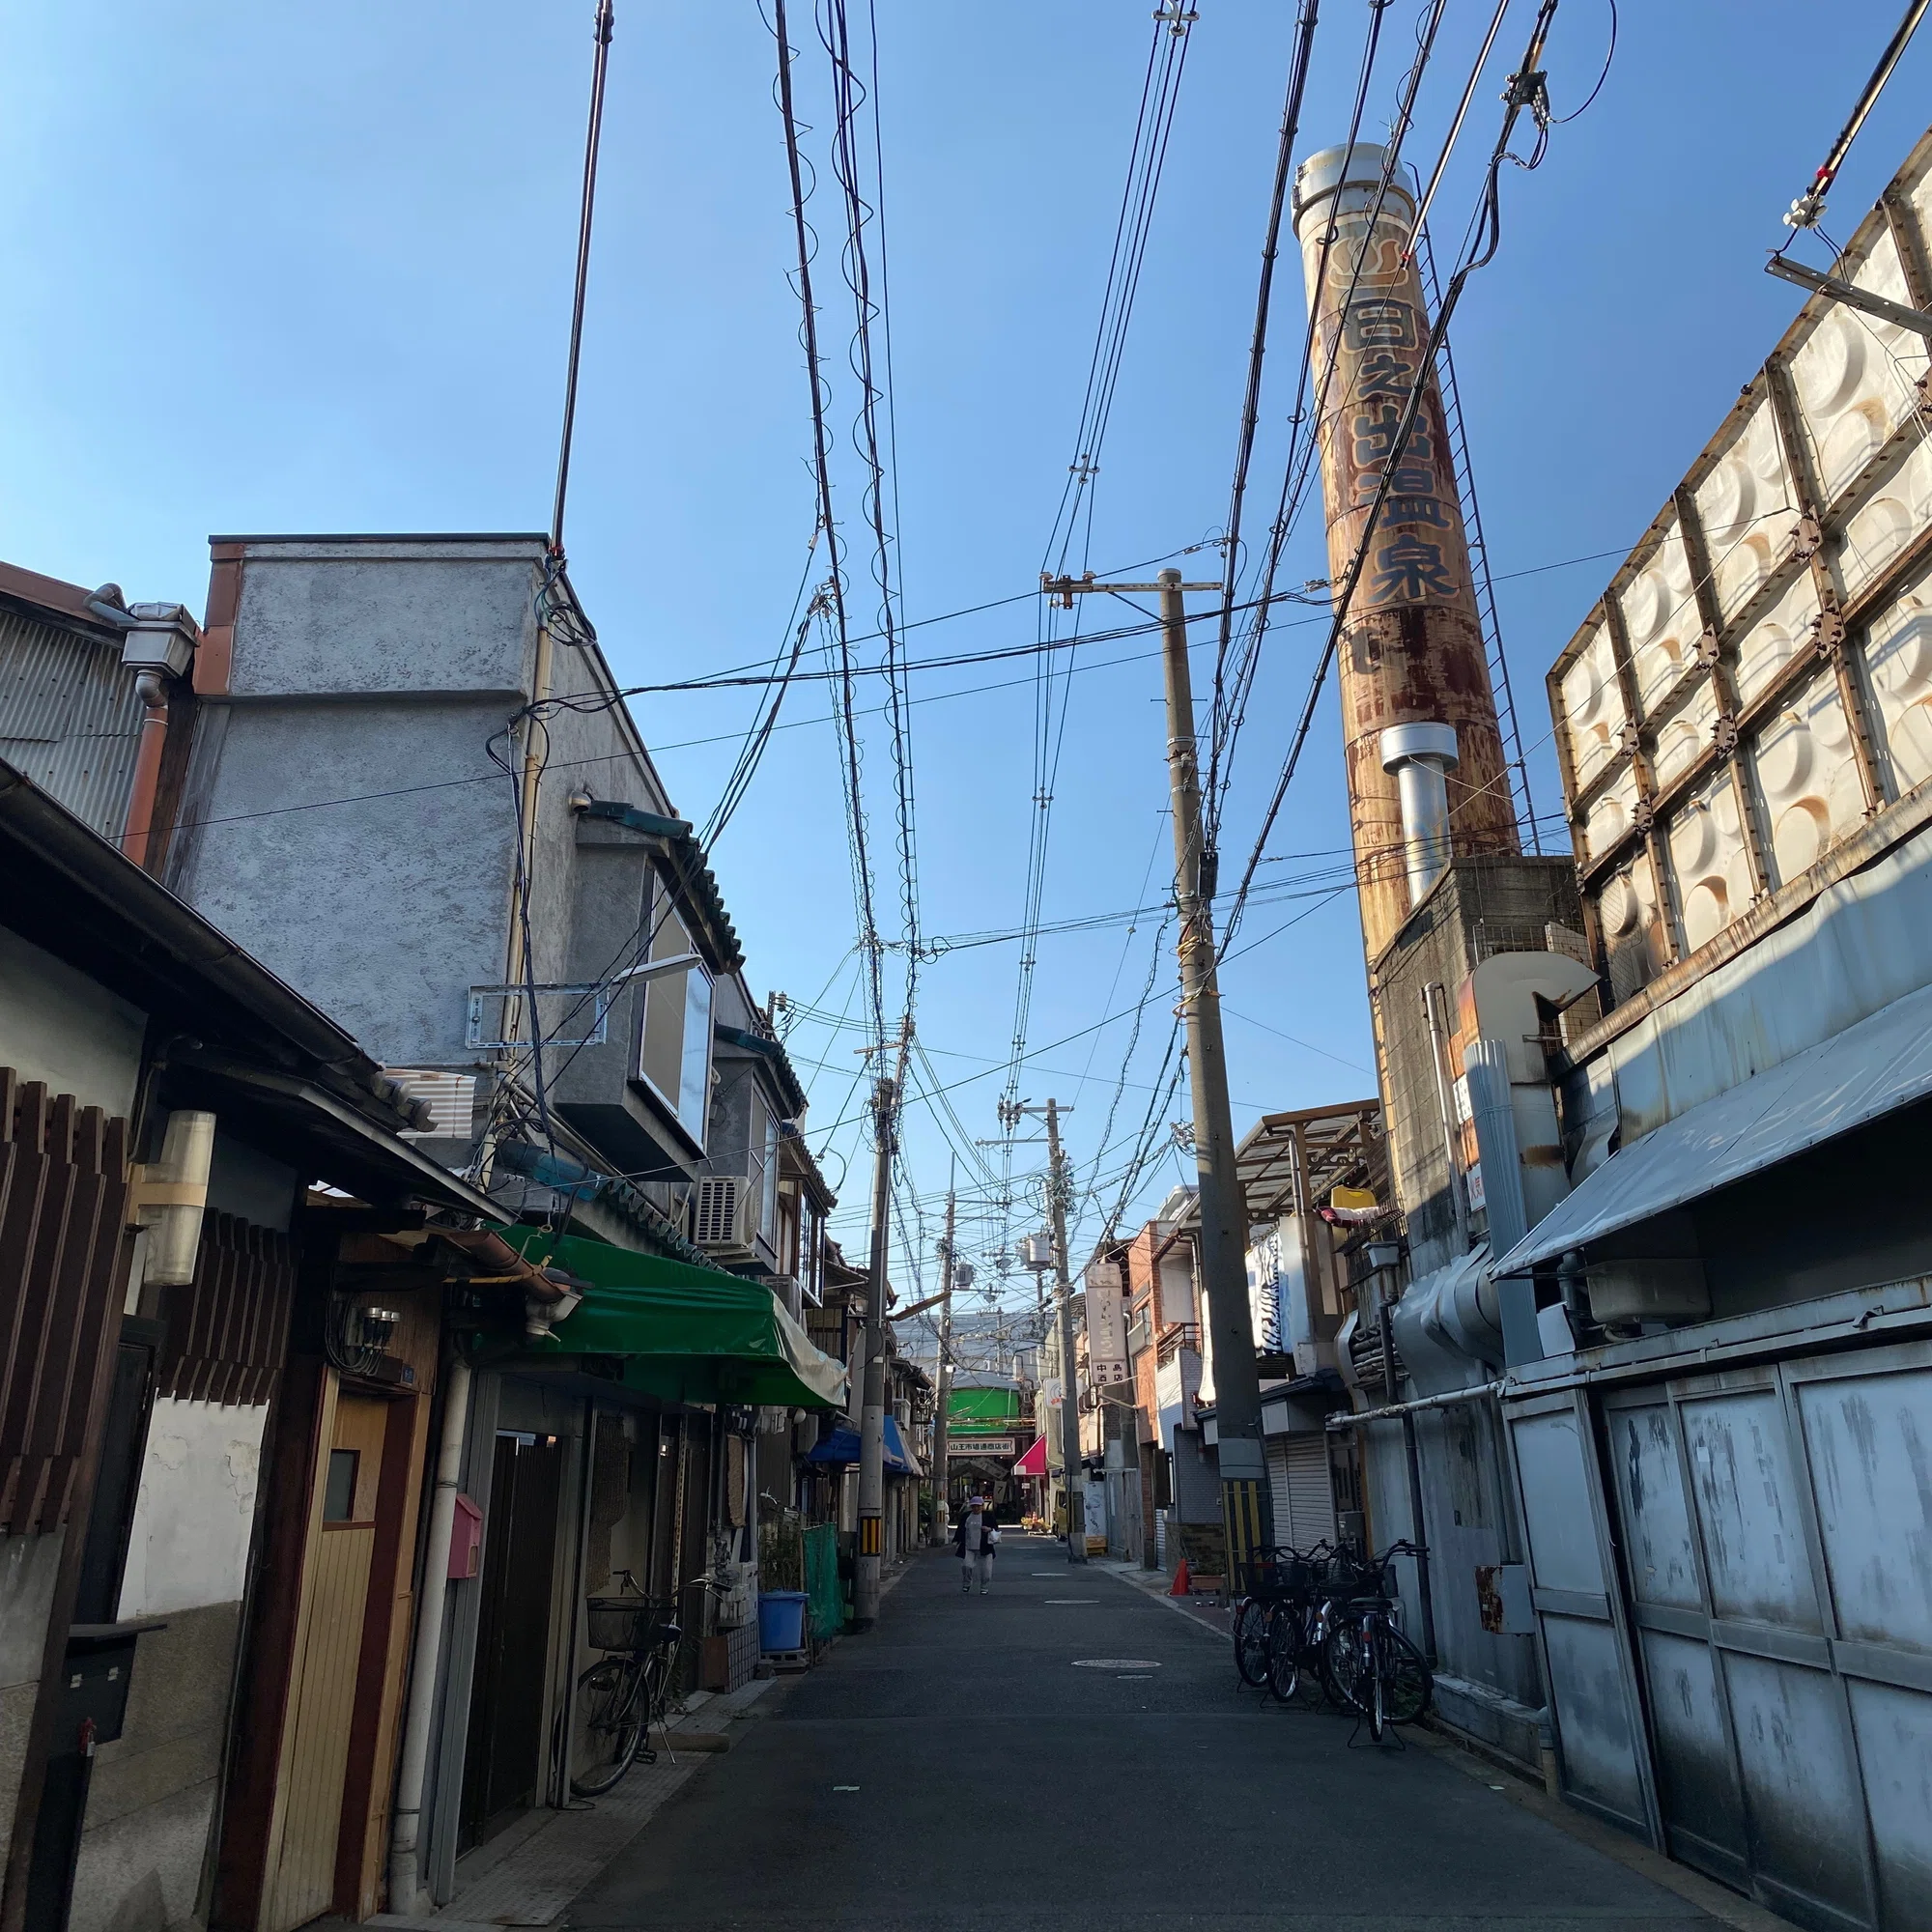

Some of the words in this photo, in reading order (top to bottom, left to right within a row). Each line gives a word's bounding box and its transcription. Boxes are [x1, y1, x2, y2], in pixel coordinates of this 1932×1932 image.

[1343, 298, 1460, 603] 日之出温泉
